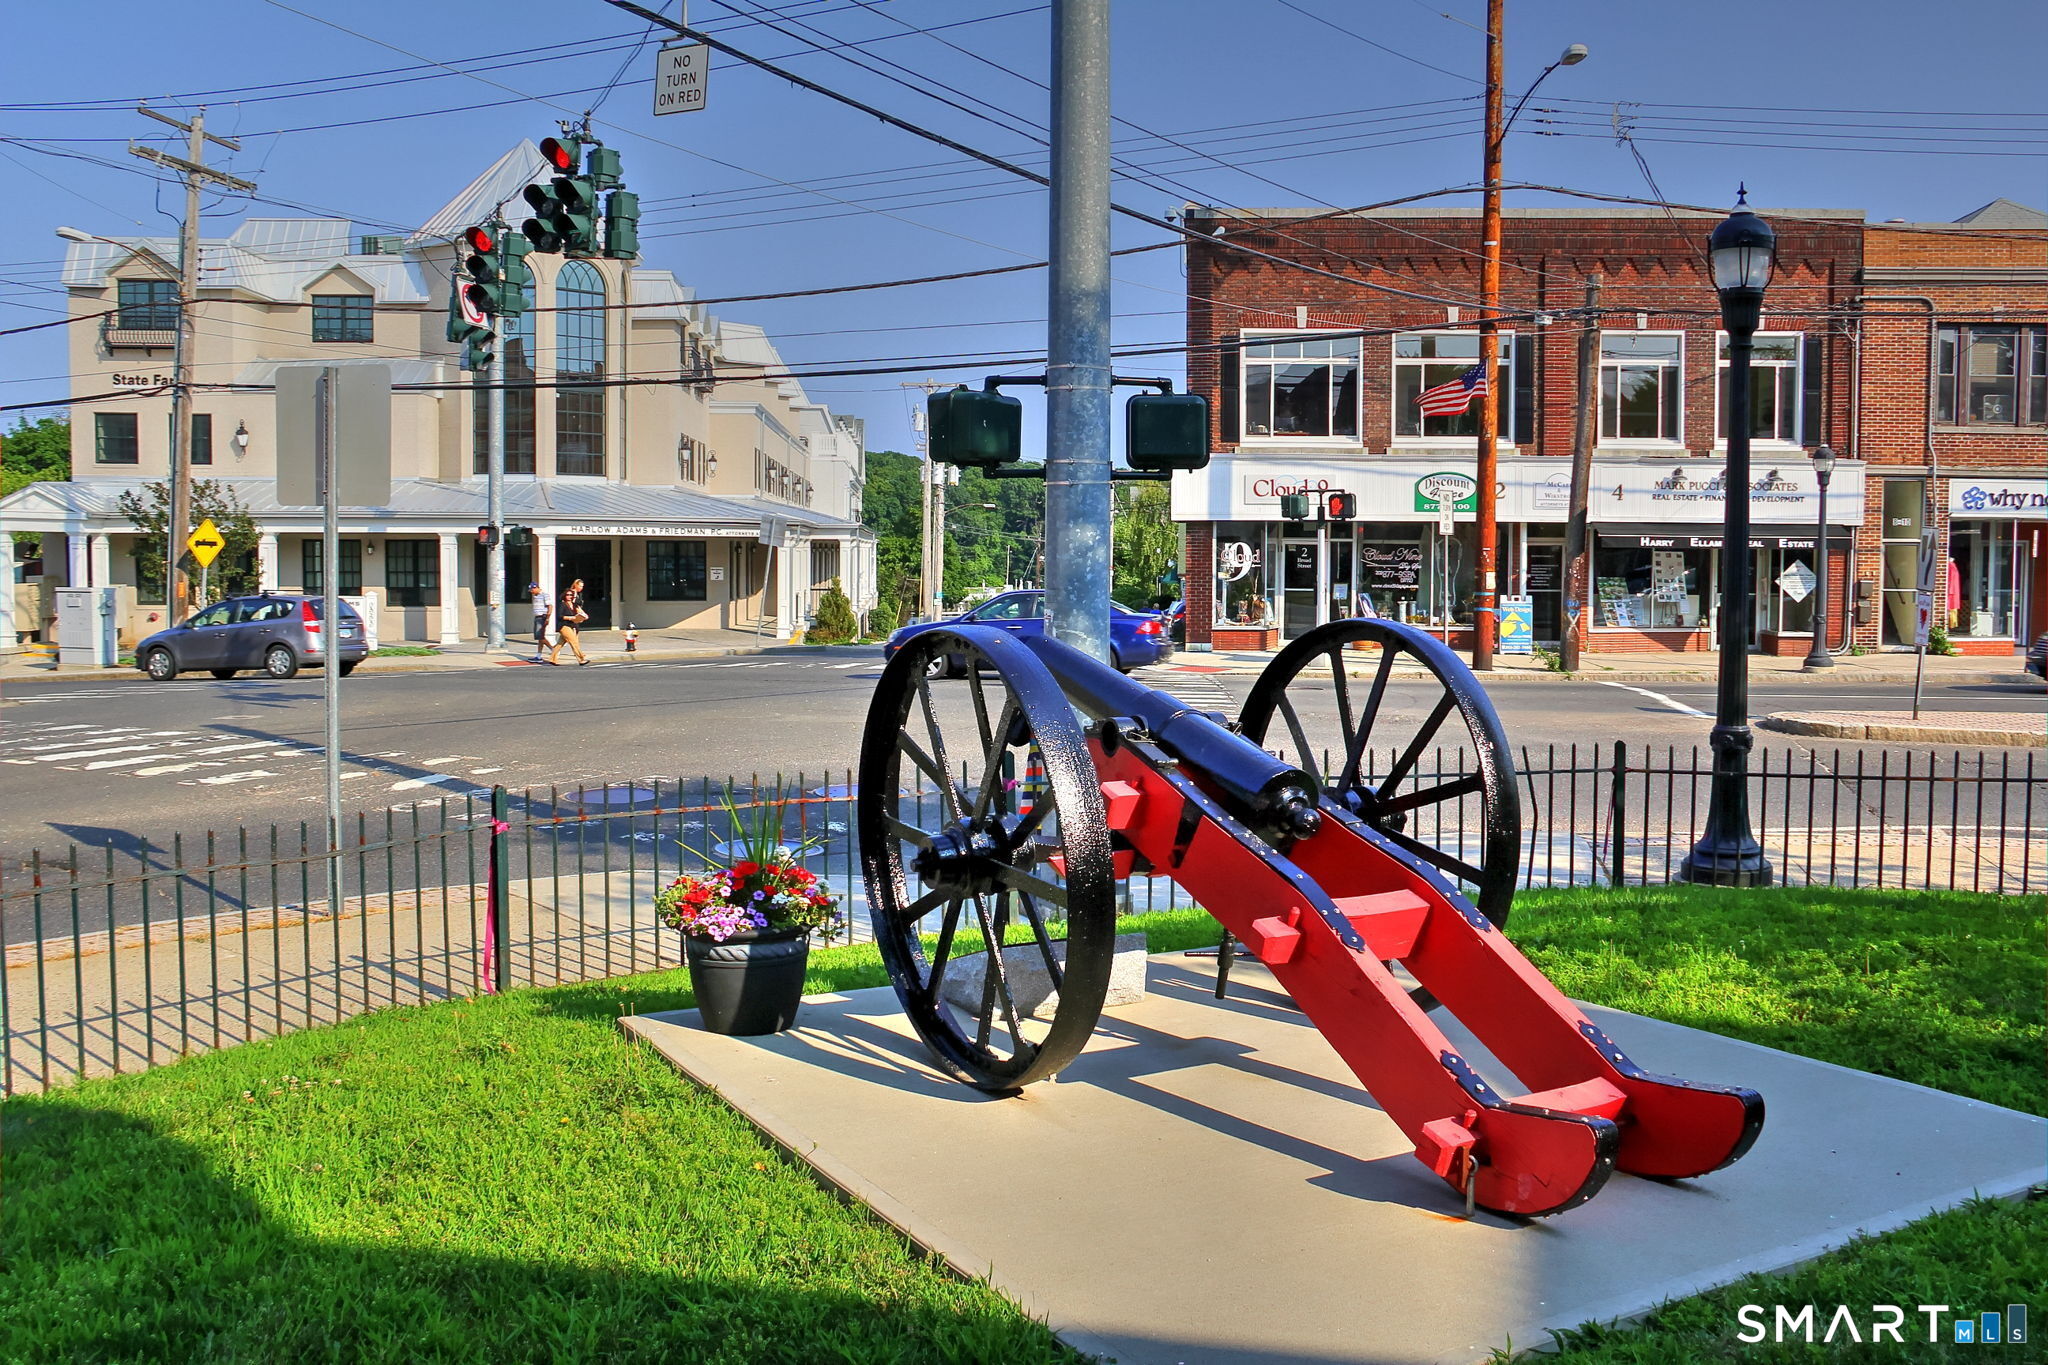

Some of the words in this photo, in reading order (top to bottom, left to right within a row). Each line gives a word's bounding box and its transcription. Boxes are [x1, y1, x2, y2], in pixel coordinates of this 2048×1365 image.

[673, 55, 691, 69] NO
[667, 72, 697, 87] TURN
[659, 93, 675, 106] ON
[678, 89, 701, 103] RED
[112, 374, 149, 386] State
[153, 374, 175, 386] Far
[1252, 478, 1309, 498] Cloud
[1424, 476, 1471, 491] Discount
[1495, 482, 1506, 499] 2
[1654, 481, 1685, 491] MARK
[1689, 481, 1720, 491] PUCCI
[1749, 482, 1798, 492] SOCIATES
[1611, 484, 1624, 501] 4
[1652, 493, 1671, 501] REAL
[1752, 495, 1805, 503] DEVELOPMENT
[1988, 488, 2029, 511] why
[616, 527, 649, 535] ADAMS
[1640, 537, 1674, 547] HARRY
[1748, 540, 1765, 548] EAL
[1778, 538, 1815, 548] ESTATE
[1220, 549, 1261, 562] Cloud
[1301, 547, 1308, 557] 2
[1362, 547, 1395, 561] Cloud
